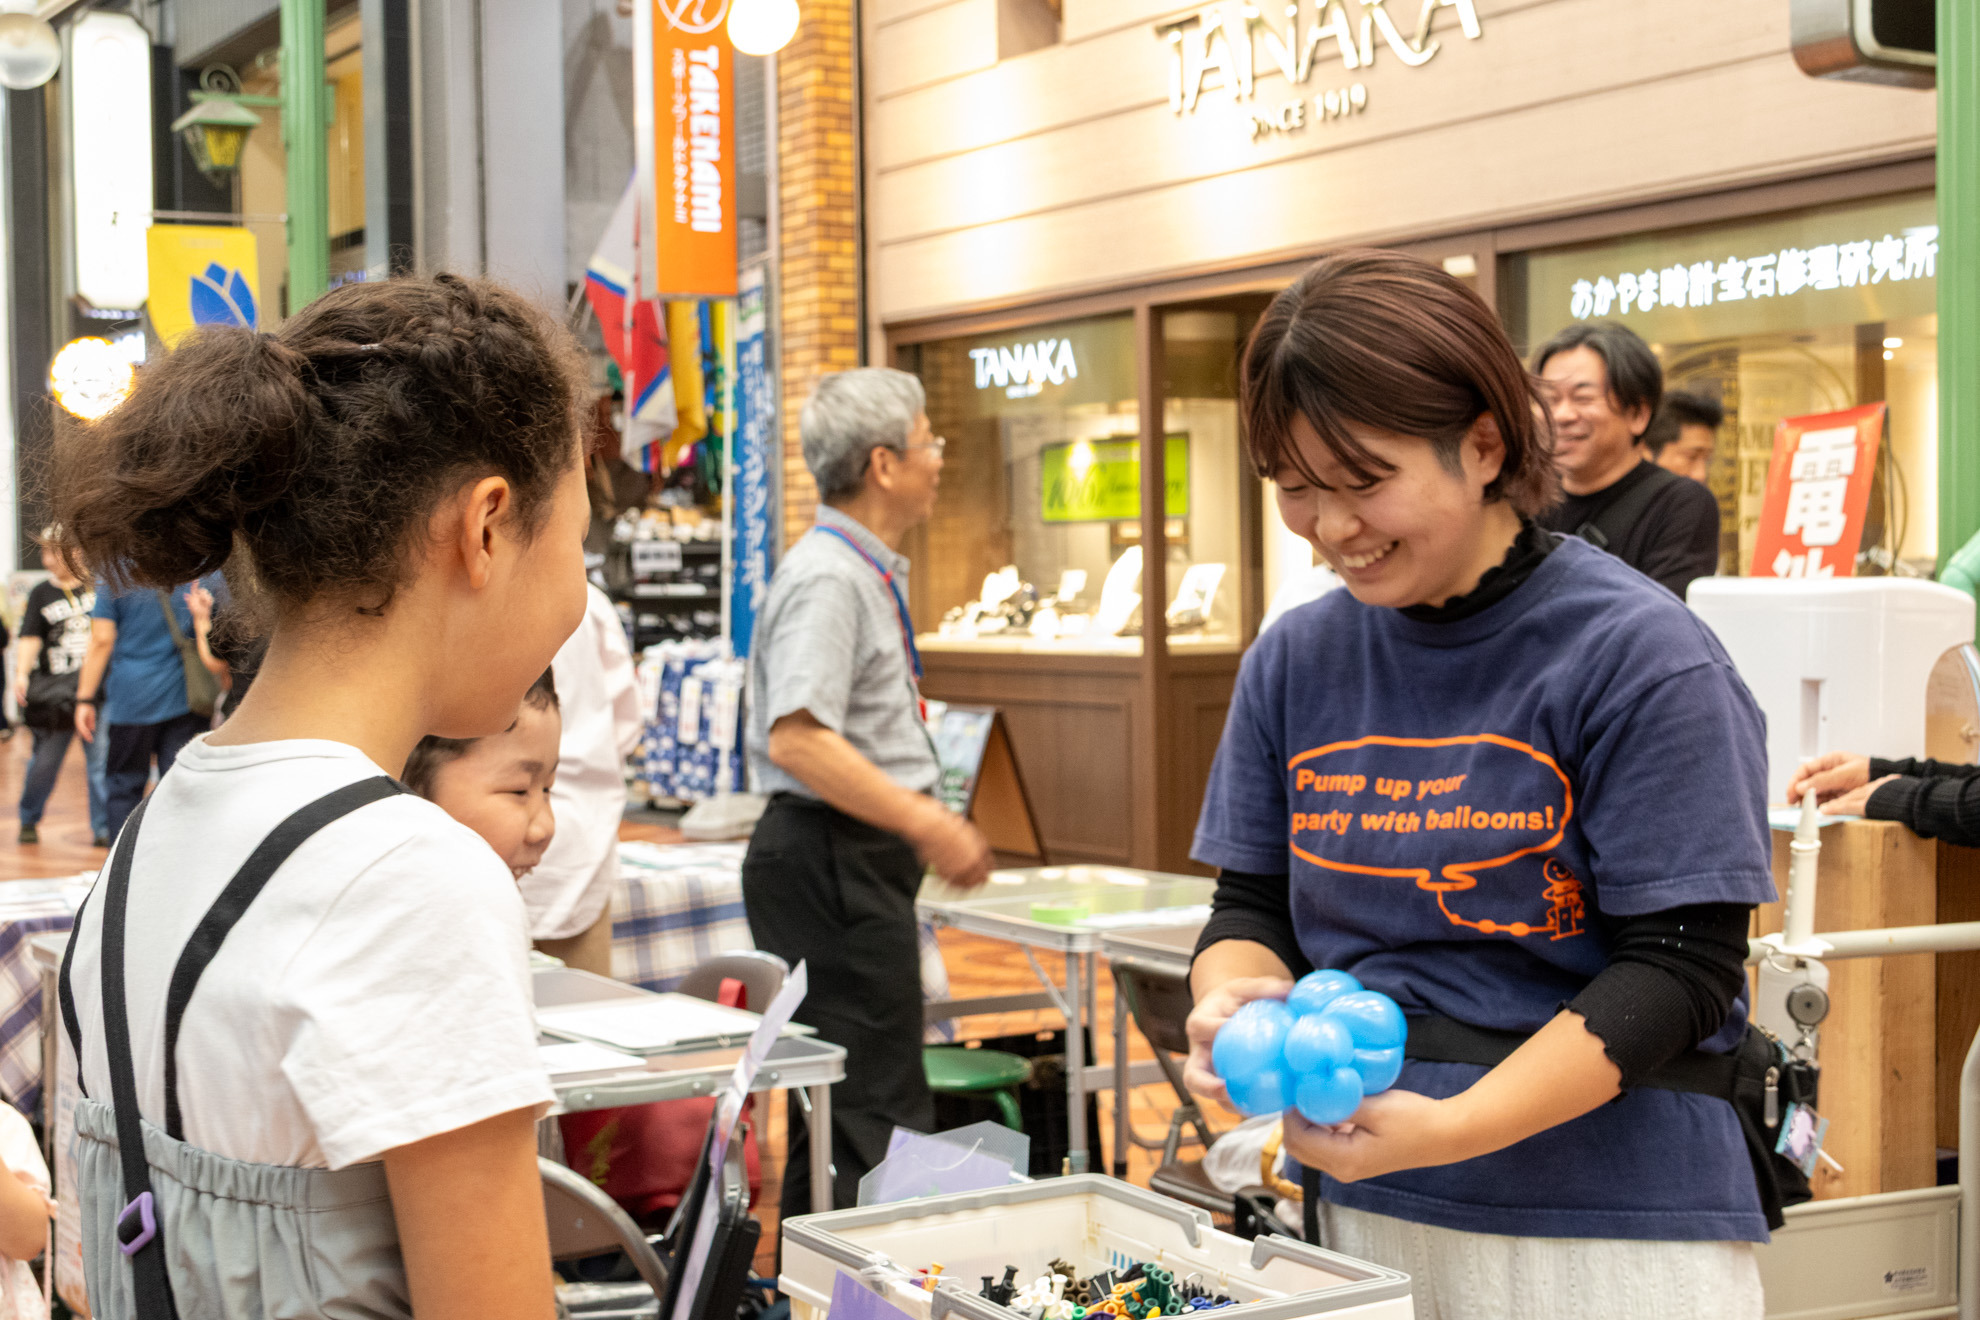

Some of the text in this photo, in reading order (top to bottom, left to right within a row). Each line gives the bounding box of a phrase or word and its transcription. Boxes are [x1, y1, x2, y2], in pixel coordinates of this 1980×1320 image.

[1155, 0, 1481, 115] TANAKA
[688, 45, 722, 233] TAKENAMI
[1248, 83, 1368, 140] SINCE 1919
[1571, 225, 1939, 320] おかやま時計宝石修理研究所
[969, 338, 1078, 389] TANAKA
[1296, 768, 1467, 801] Pump up your
[1292, 805, 1554, 835] party with balloons!
